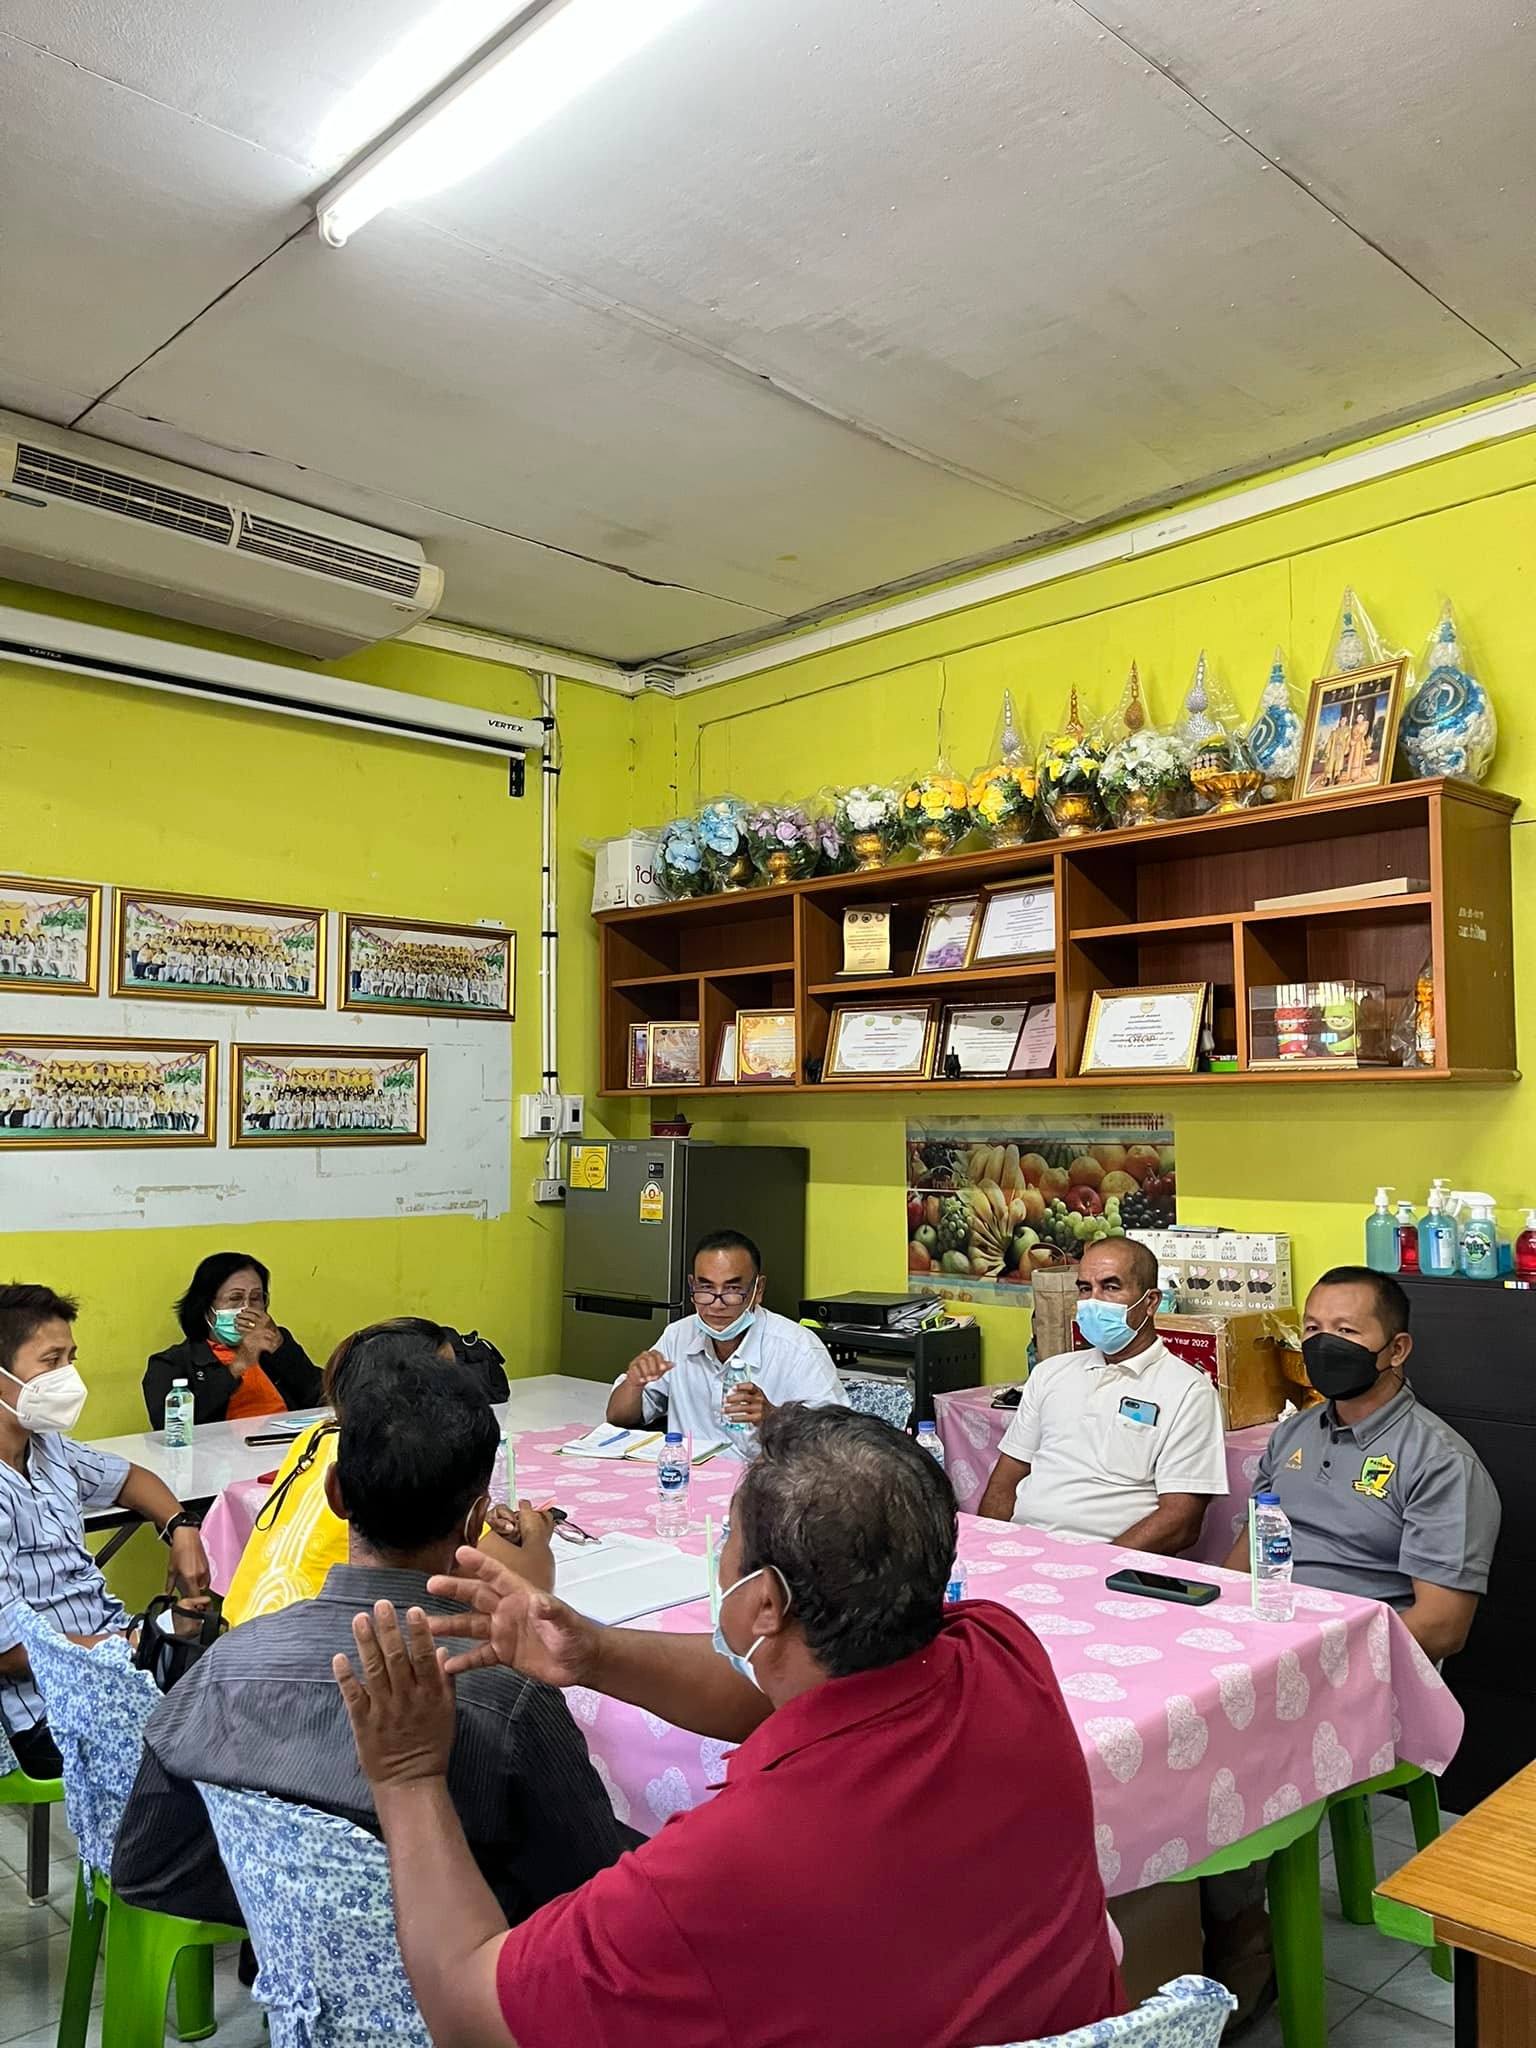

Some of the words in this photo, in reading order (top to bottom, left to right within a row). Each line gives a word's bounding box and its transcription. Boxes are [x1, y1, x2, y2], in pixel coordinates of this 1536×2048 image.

[488, 719, 524, 732] VERTEX
[1174, 1336, 1190, 1346] Year
[1191, 1338, 1209, 1348] 2022
